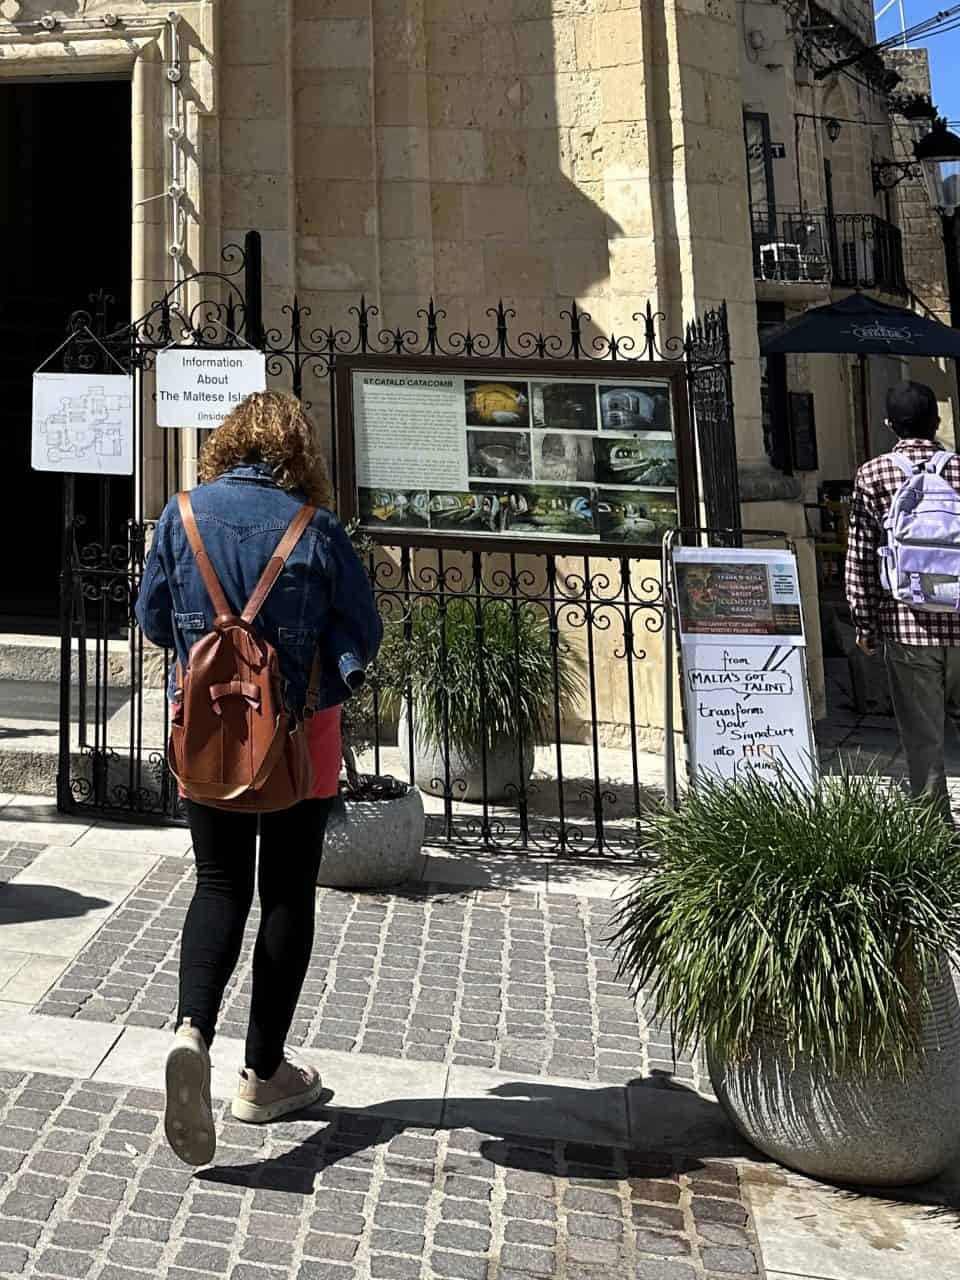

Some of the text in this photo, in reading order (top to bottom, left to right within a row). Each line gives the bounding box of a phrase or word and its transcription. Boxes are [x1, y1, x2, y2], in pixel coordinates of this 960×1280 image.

[182, 357, 243, 368] Information
[196, 373, 229, 385] About
[159, 391, 179, 401] The
[183, 391, 224, 402] Maltese
[721, 650, 748, 671] from
[745, 673, 767, 681] GOT
[698, 702, 764, 720] transforms
[716, 719, 748, 735] your
[712, 744, 778, 758] into ART
